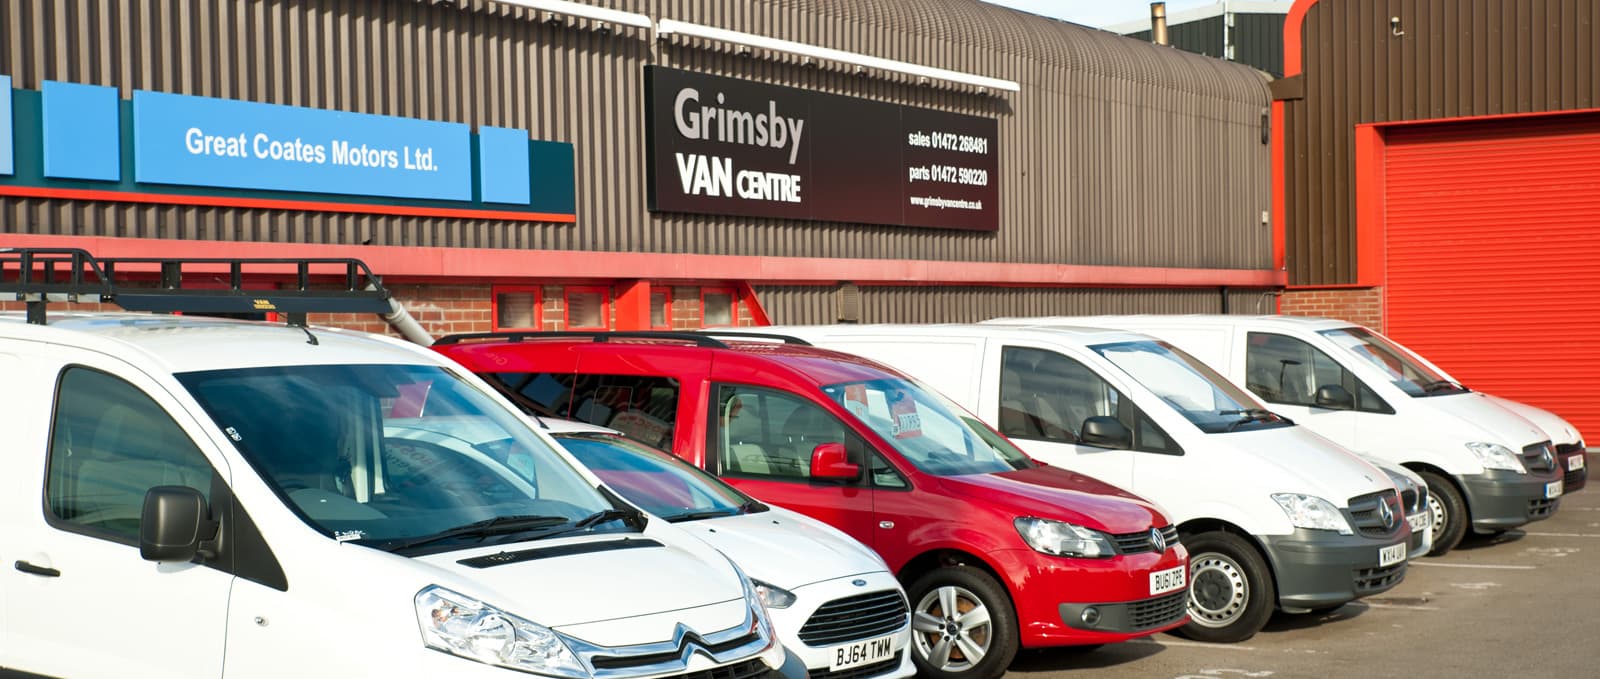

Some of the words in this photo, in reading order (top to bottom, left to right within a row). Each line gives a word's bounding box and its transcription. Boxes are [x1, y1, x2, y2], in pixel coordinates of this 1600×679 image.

[674, 88, 804, 165] Grimsby
[185, 127, 248, 158] Great
[253, 132, 326, 164] Coates
[331, 140, 399, 169] Motors
[403, 146, 438, 172] Ltd.
[908, 132, 930, 148] sales
[931, 132, 958, 151] 01472
[958, 134, 988, 155] 268481
[675, 152, 733, 198] VAN
[736, 169, 802, 203] CENTRE
[909, 165, 930, 183] parts
[931, 164, 957, 183] 01472
[958, 167, 988, 186] 590220
[909, 195, 983, 210] www.grimsbyvancentre.co.uk
[836, 642, 867, 667] BJ64
[870, 636, 891, 659] TWM
